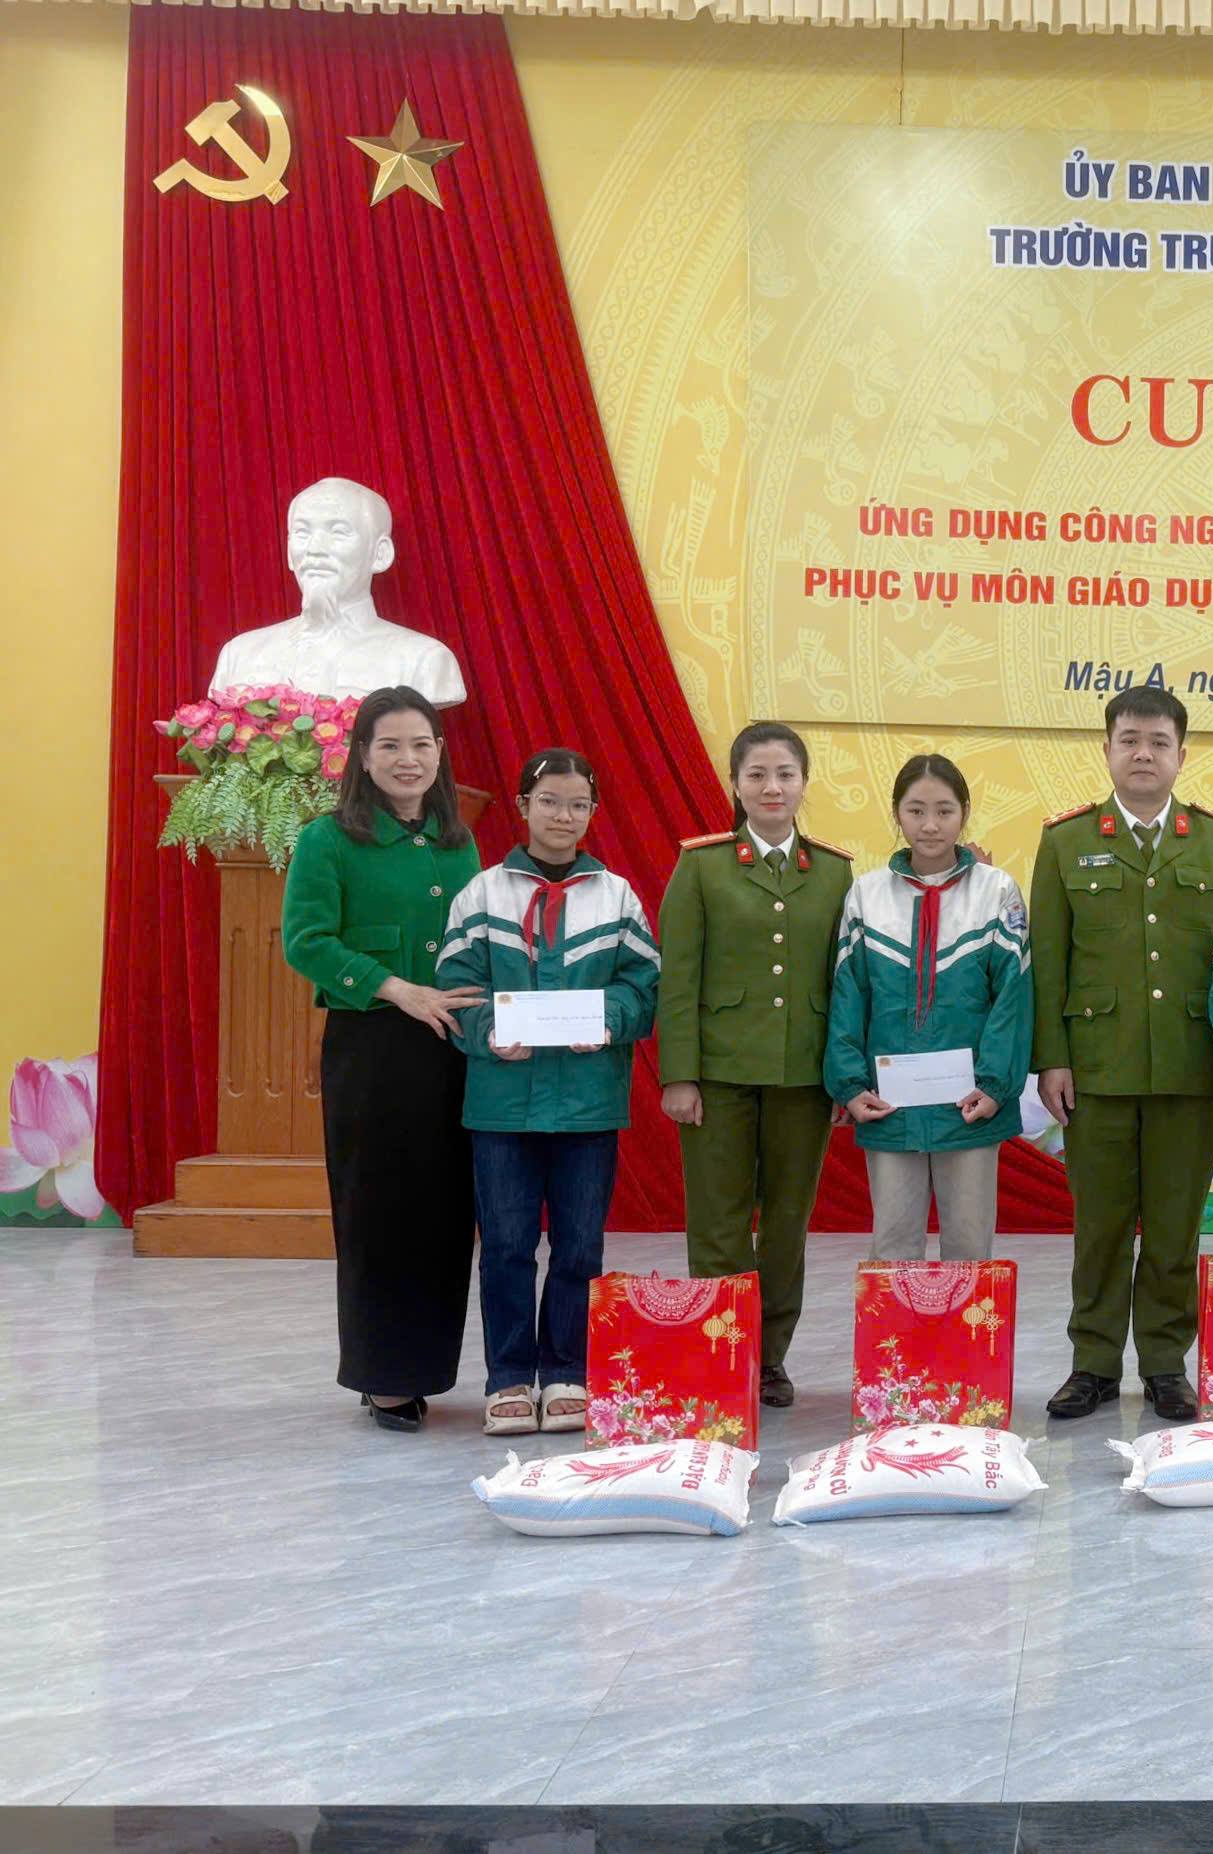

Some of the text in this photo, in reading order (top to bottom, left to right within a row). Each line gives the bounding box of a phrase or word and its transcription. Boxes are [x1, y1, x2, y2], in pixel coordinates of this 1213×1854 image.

[1064, 146, 1115, 199] ỦY
[1127, 162, 1210, 202] BAN
[989, 219, 1148, 269] TRƯỜNG
[859, 497, 934, 537] ỨNG
[948, 508, 1047, 545] DỤNG
[1059, 506, 1157, 544] CÔNG
[803, 566, 902, 604] PHỤC
[914, 571, 959, 606] VỤ
[970, 570, 1055, 605] MÔN
[1067, 568, 1151, 608] GIÁO
[1064, 661, 1134, 700] Mậu
[681, 1464, 706, 1490] ĐẶC
[984, 1461, 1003, 1490] Bắc
